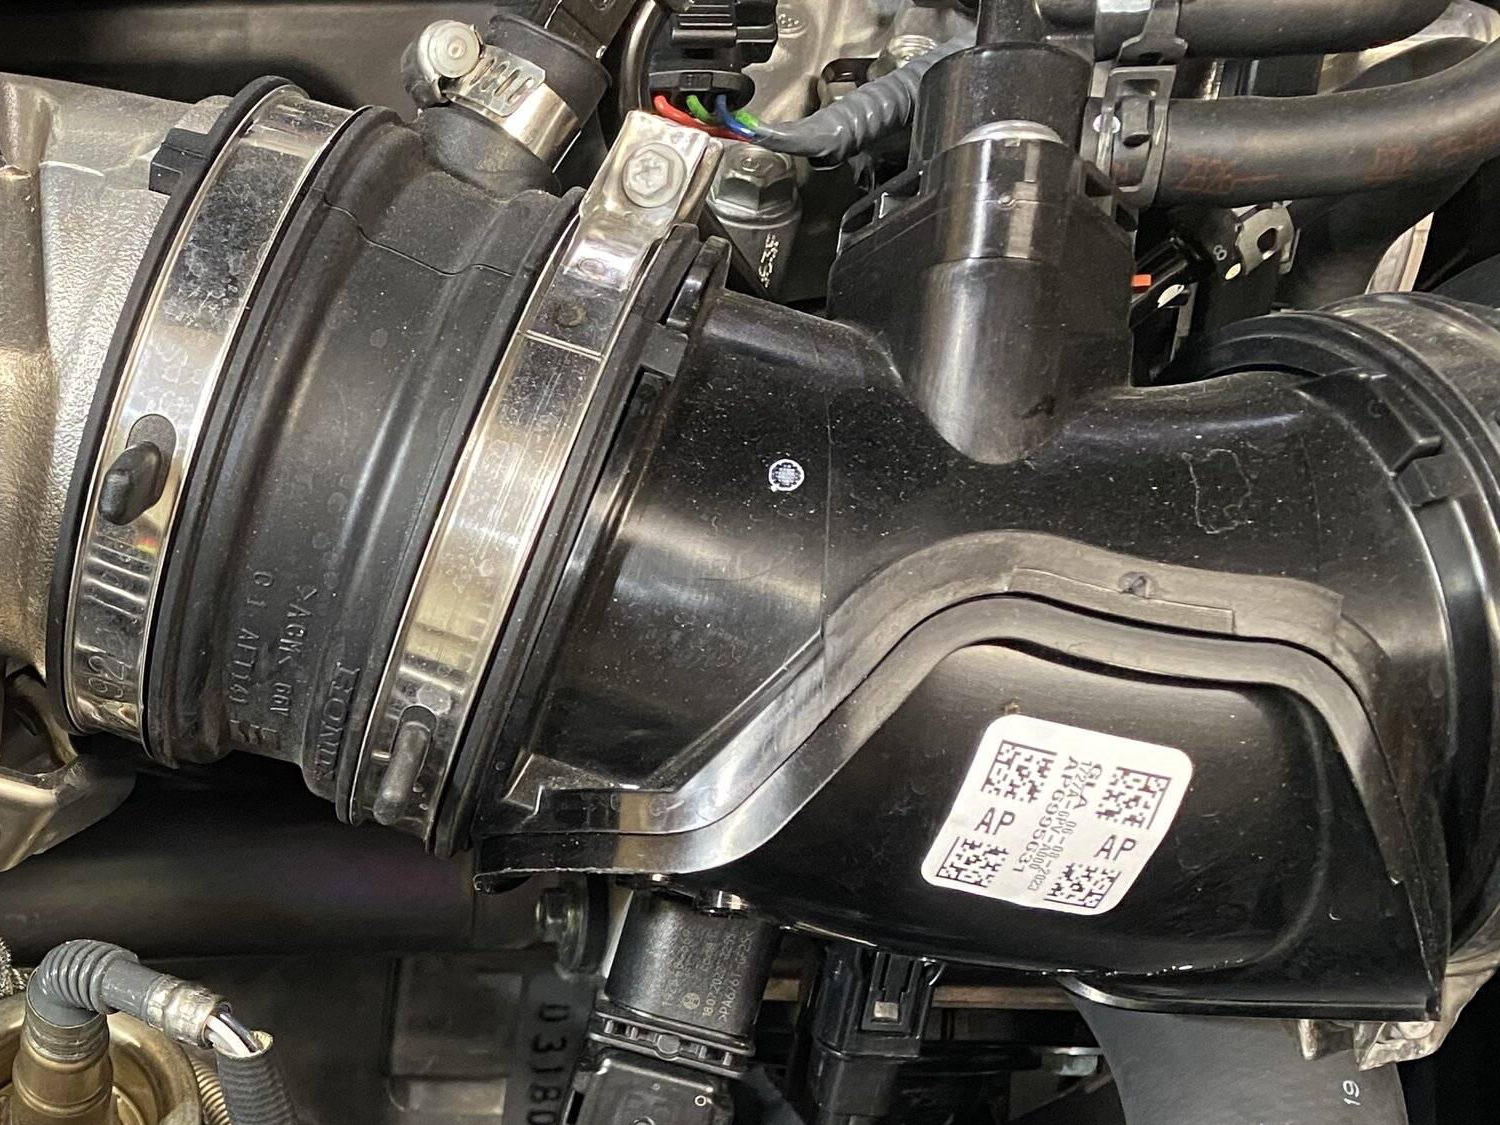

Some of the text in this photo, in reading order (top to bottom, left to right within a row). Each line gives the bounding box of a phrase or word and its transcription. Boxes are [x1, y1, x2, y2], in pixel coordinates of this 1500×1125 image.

[974, 806, 1016, 836] AP
[1094, 833, 1138, 862] AP
[1342, 1079, 1361, 1106] 19
